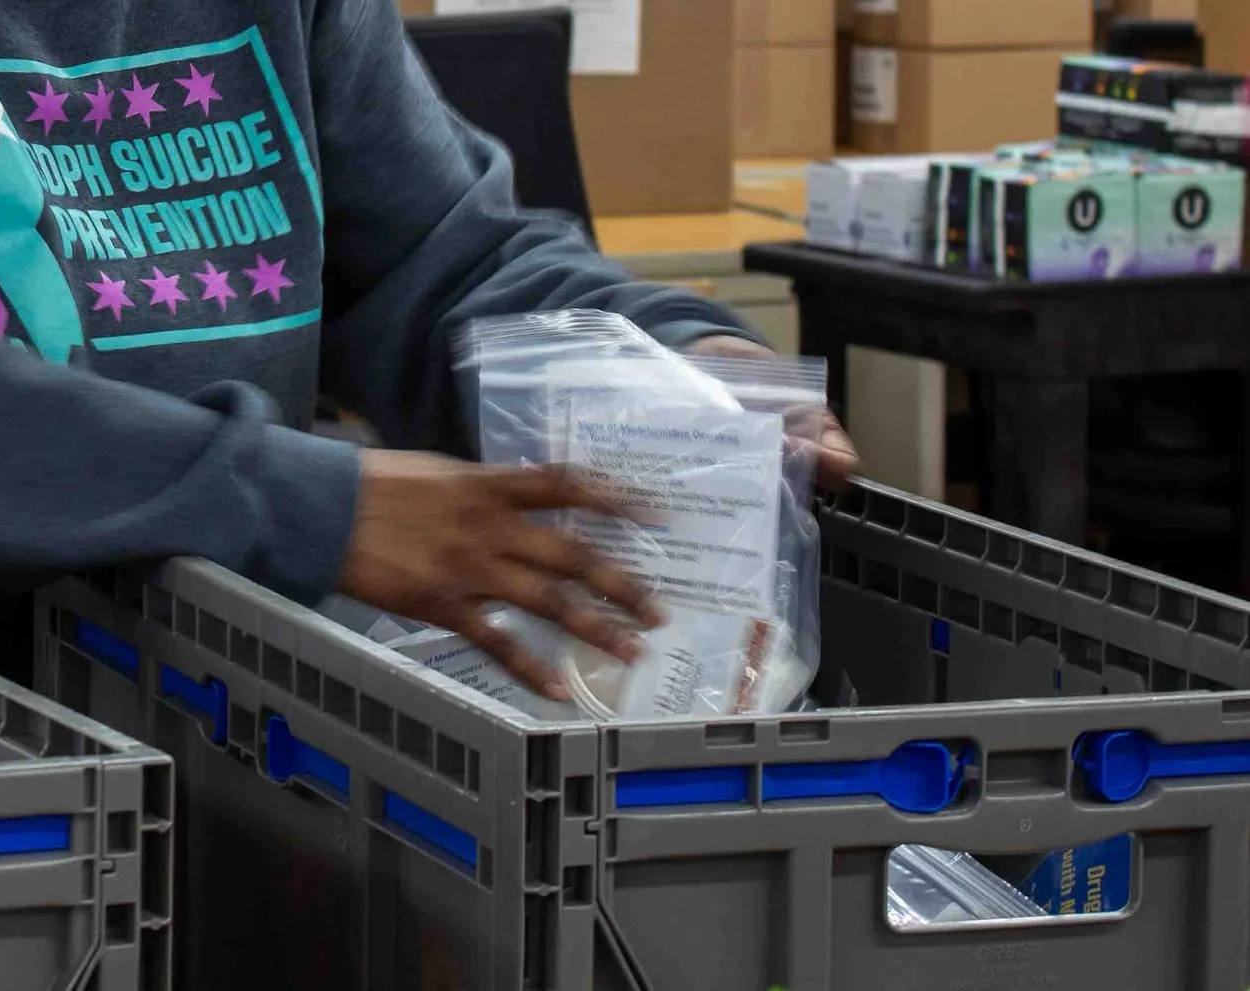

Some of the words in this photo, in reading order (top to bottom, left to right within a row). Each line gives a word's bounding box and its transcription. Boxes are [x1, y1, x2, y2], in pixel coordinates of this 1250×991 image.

[109, 110, 282, 193] SUICIDE
[49, 180, 293, 260] PREVENTION
[1061, 848, 1076, 897] with
[1084, 864, 1106, 913] Drug
